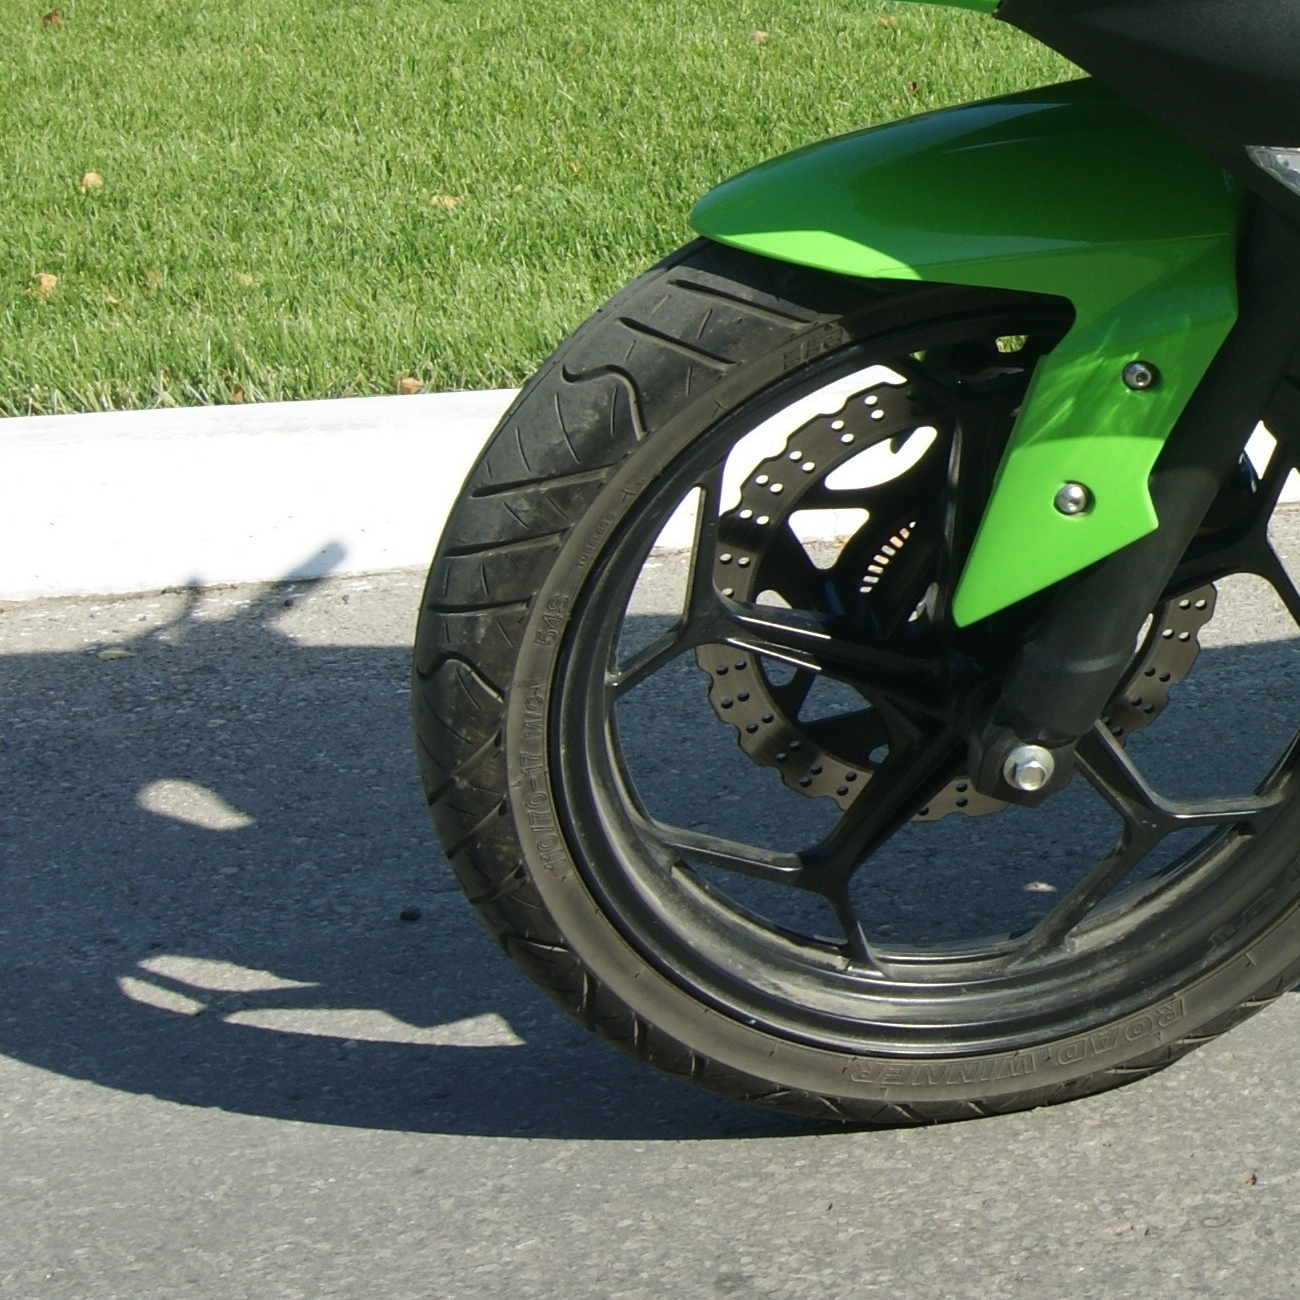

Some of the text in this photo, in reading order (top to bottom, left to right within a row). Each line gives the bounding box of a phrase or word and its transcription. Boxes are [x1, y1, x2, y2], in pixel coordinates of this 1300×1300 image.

[534, 591, 570, 647] 54S
[850, 994, 1186, 1086] ROAD WINNER
